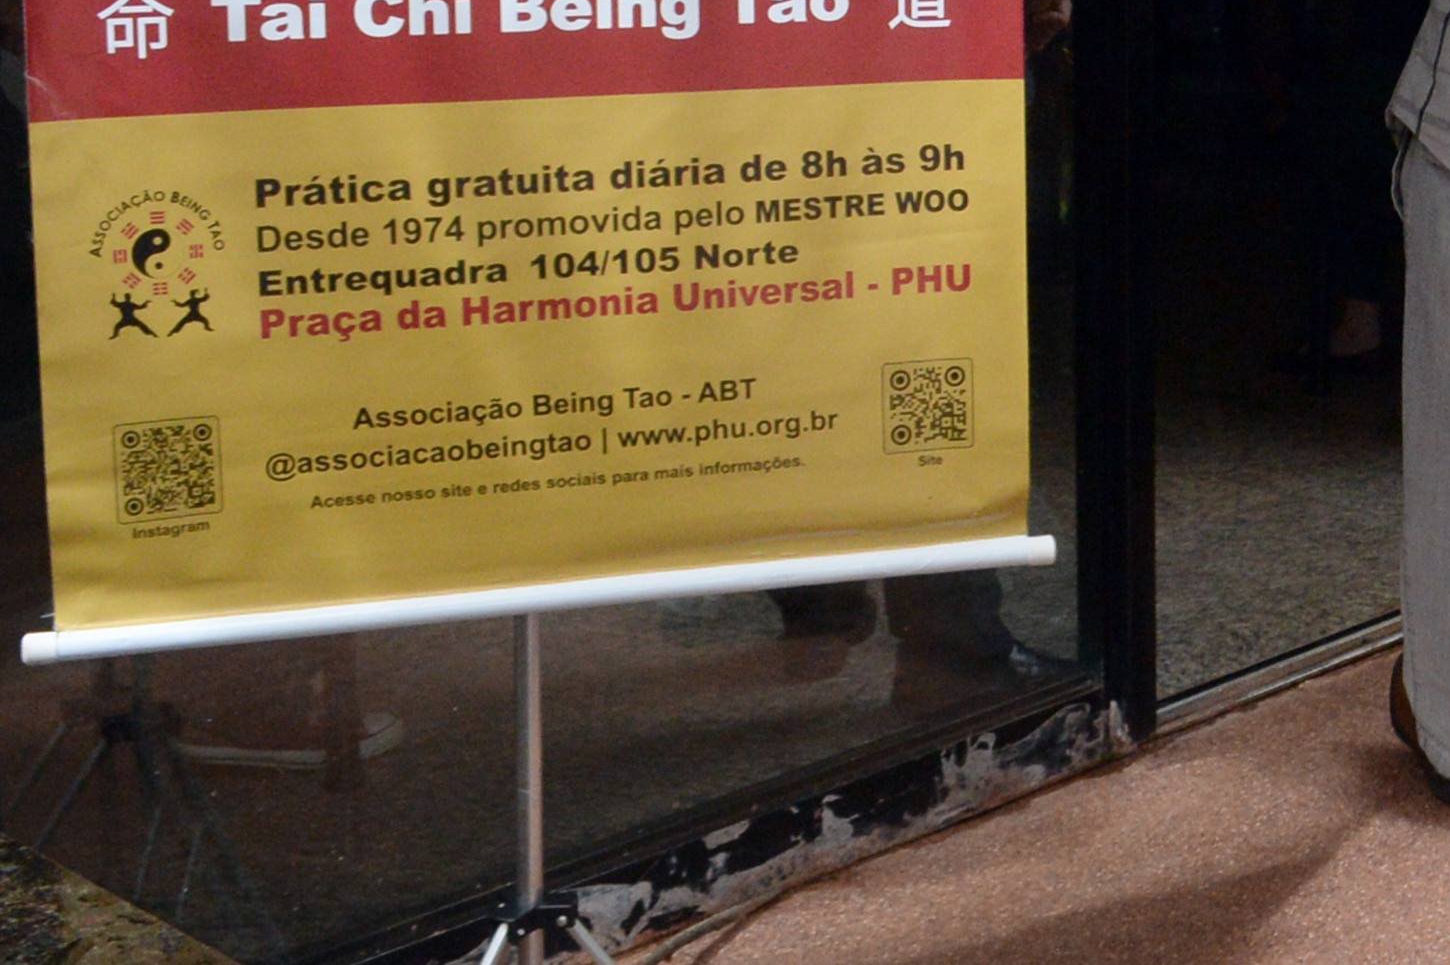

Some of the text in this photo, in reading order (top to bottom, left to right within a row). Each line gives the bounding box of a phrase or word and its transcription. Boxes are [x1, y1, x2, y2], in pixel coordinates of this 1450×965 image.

[255, 143, 965, 208] Prática gratuita diária de 8h às 9h
[170, 191, 211, 221] BEING
[207, 220, 225, 251] TAO
[256, 189, 969, 253] Desde 1974 promovida pelo MESTRE WOO
[258, 241, 799, 297] Entrequadra 104/105 Norte
[260, 308, 382, 342] Praça
[397, 300, 447, 330] da
[461, 286, 659, 326] Harmonia
[673, 270, 853, 311] Universal
[891, 263, 971, 296] PHU
[353, 398, 522, 430] Associação
[533, 392, 613, 417] Being
[623, 387, 672, 409] Tao
[698, 378, 757, 404] ABT
[266, 433, 591, 482] @associacaobeingtao
[617, 410, 838, 448] www.phu.org.br
[918, 455, 943, 468] Site
[310, 457, 805, 509] Acesse nosso site e redes sociais para mais informações.
[132, 522, 210, 538] Instagram
